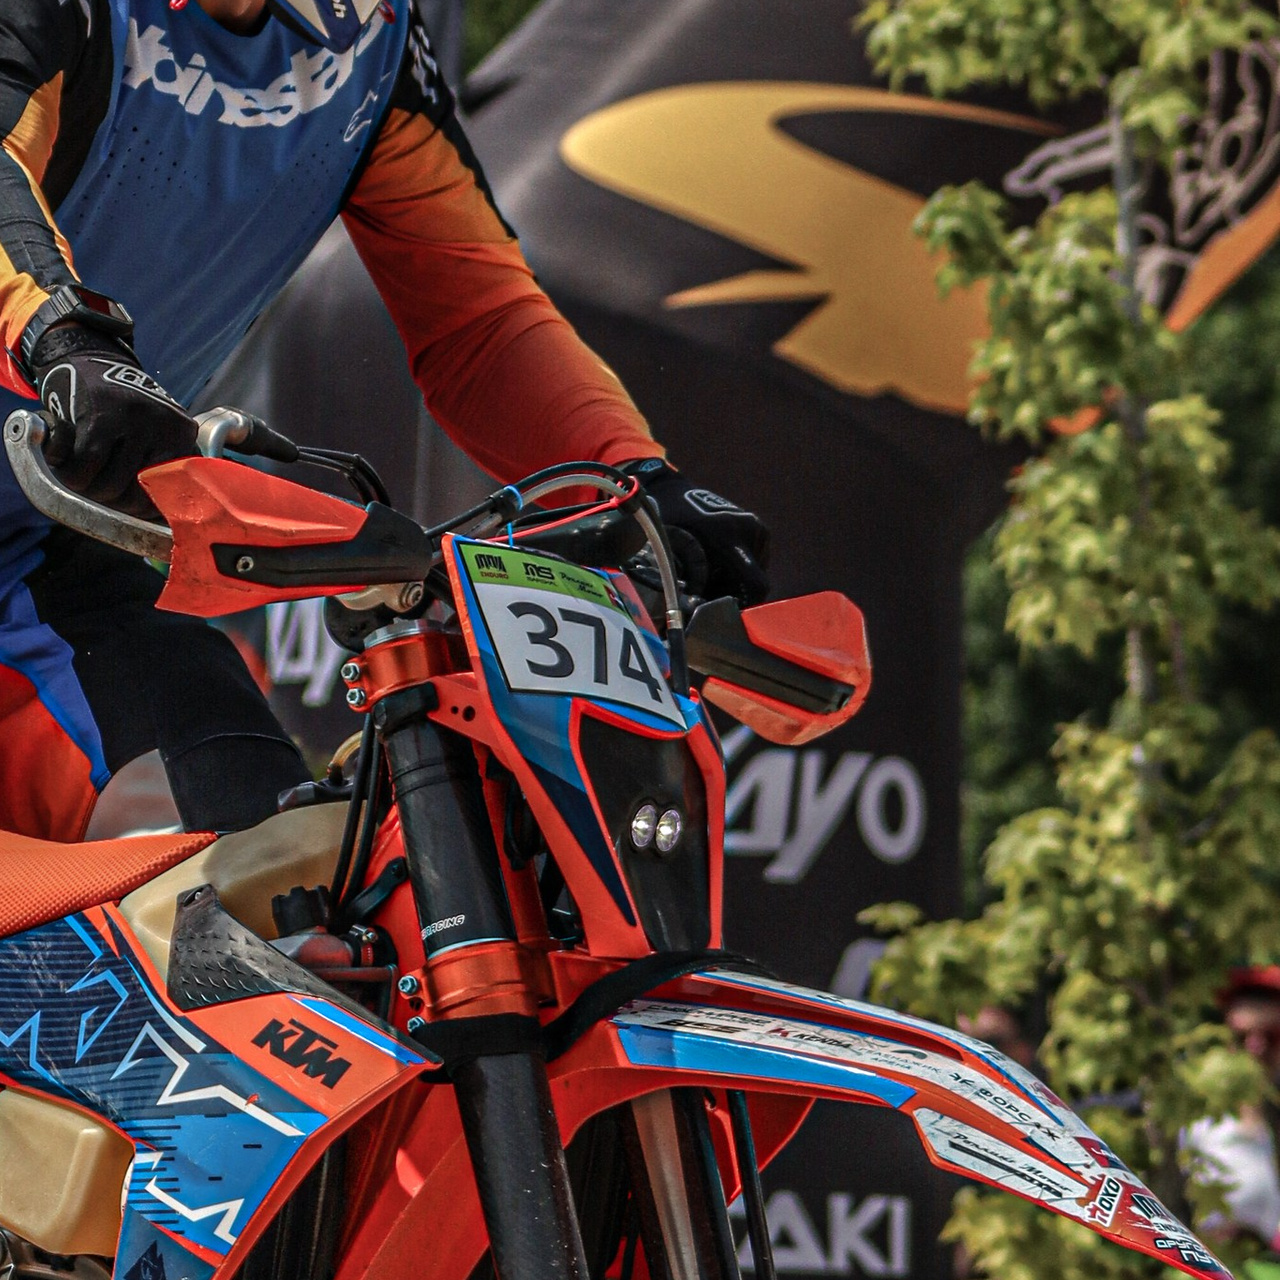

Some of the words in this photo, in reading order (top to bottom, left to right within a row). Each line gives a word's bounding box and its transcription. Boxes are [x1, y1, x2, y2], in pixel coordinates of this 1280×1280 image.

[506, 601, 664, 704] 374
[250, 1017, 353, 1090] KTM
[793, 1032, 852, 1050] KENDA
